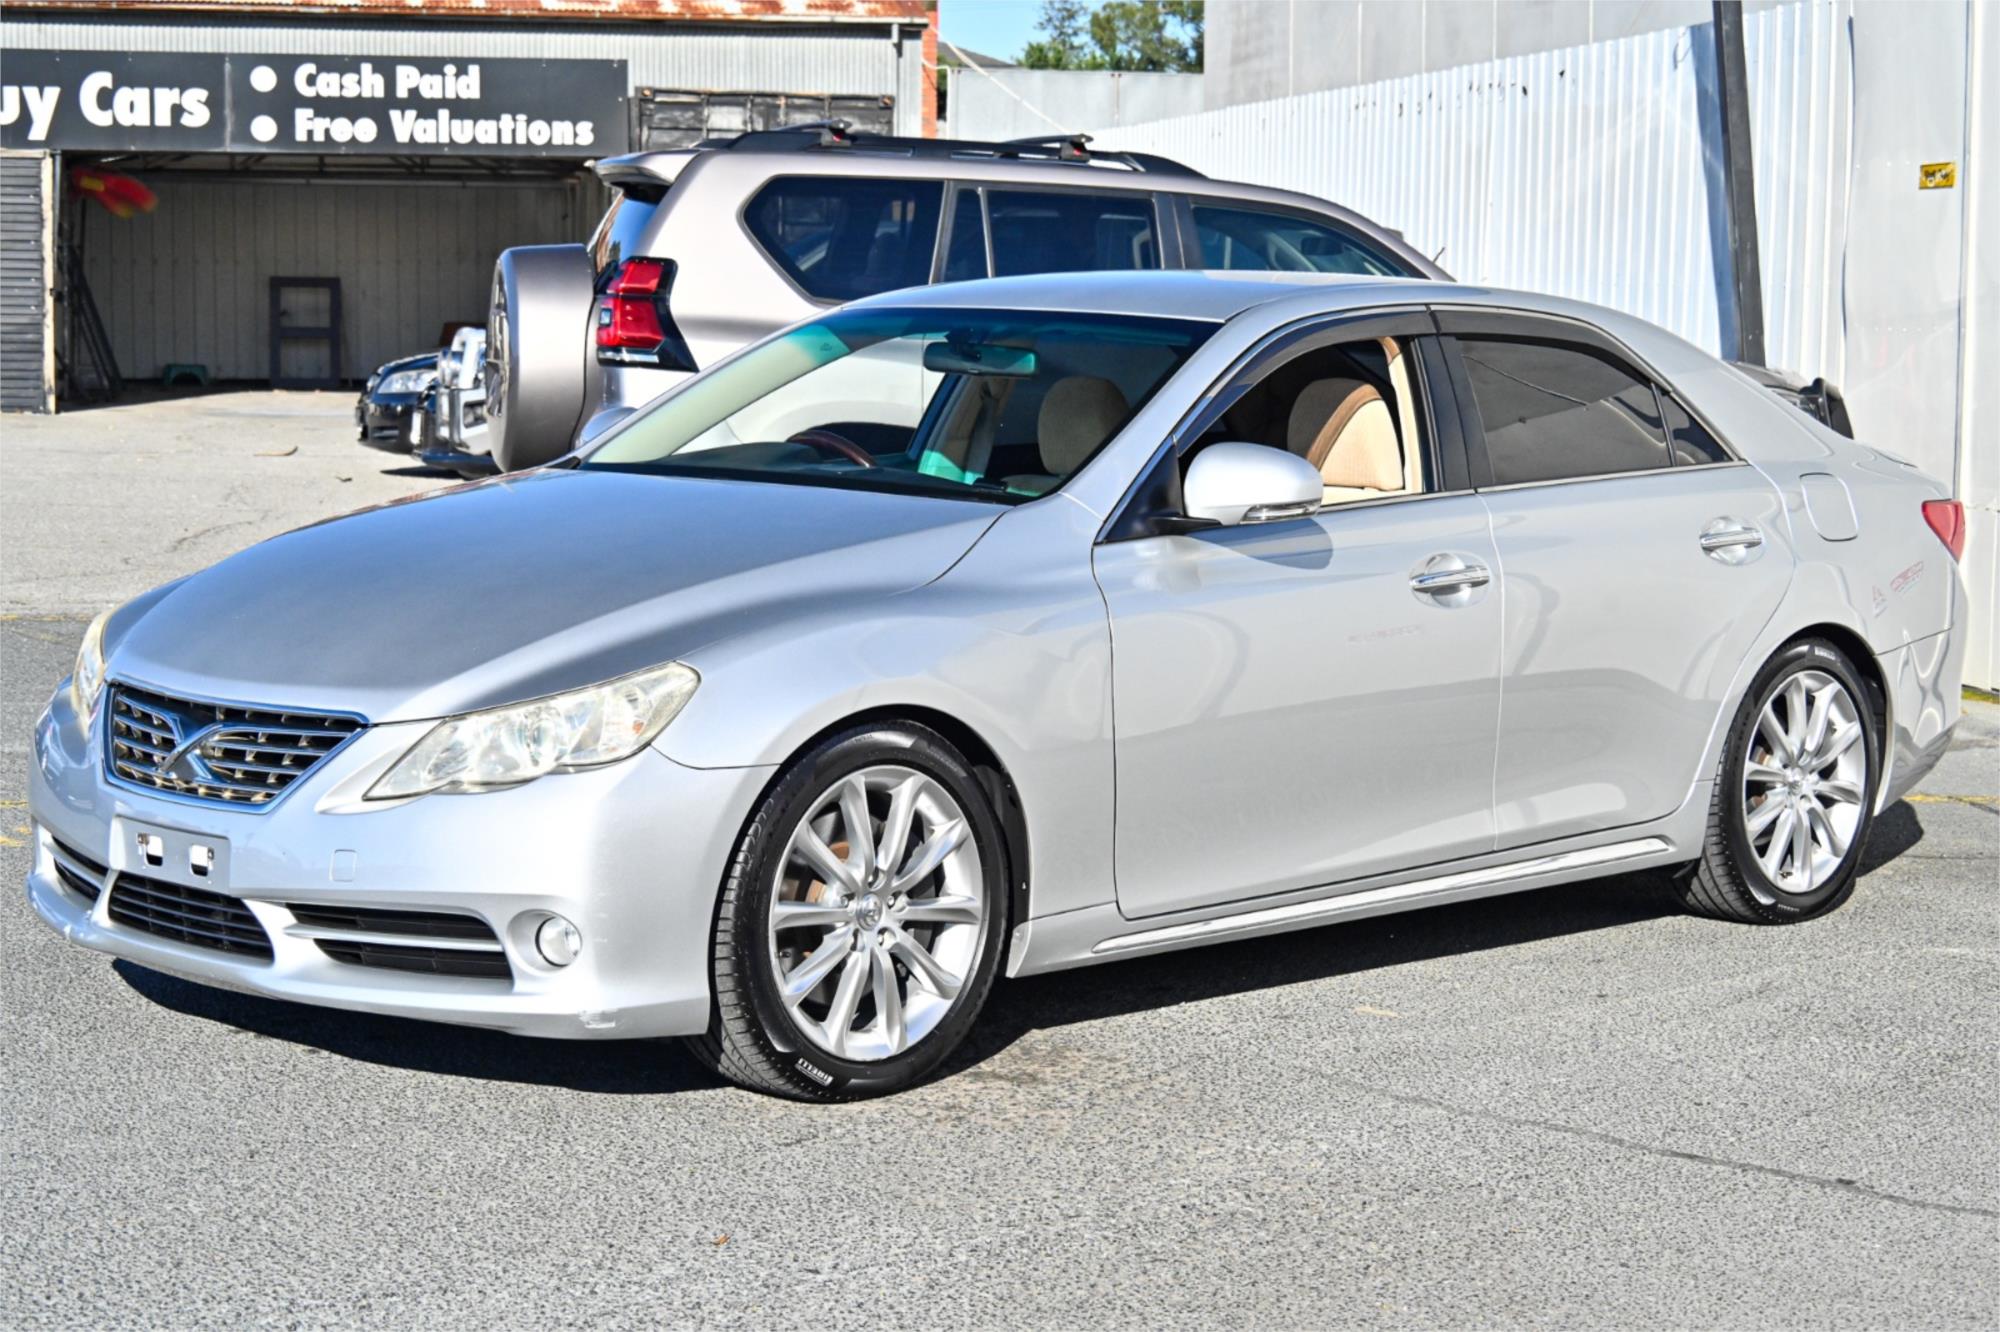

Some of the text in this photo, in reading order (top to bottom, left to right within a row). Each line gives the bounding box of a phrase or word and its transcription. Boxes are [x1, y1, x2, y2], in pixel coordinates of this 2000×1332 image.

[79, 71, 211, 128] Cars
[294, 62, 480, 99] Cash Paid
[389, 108, 594, 146] Valuations
